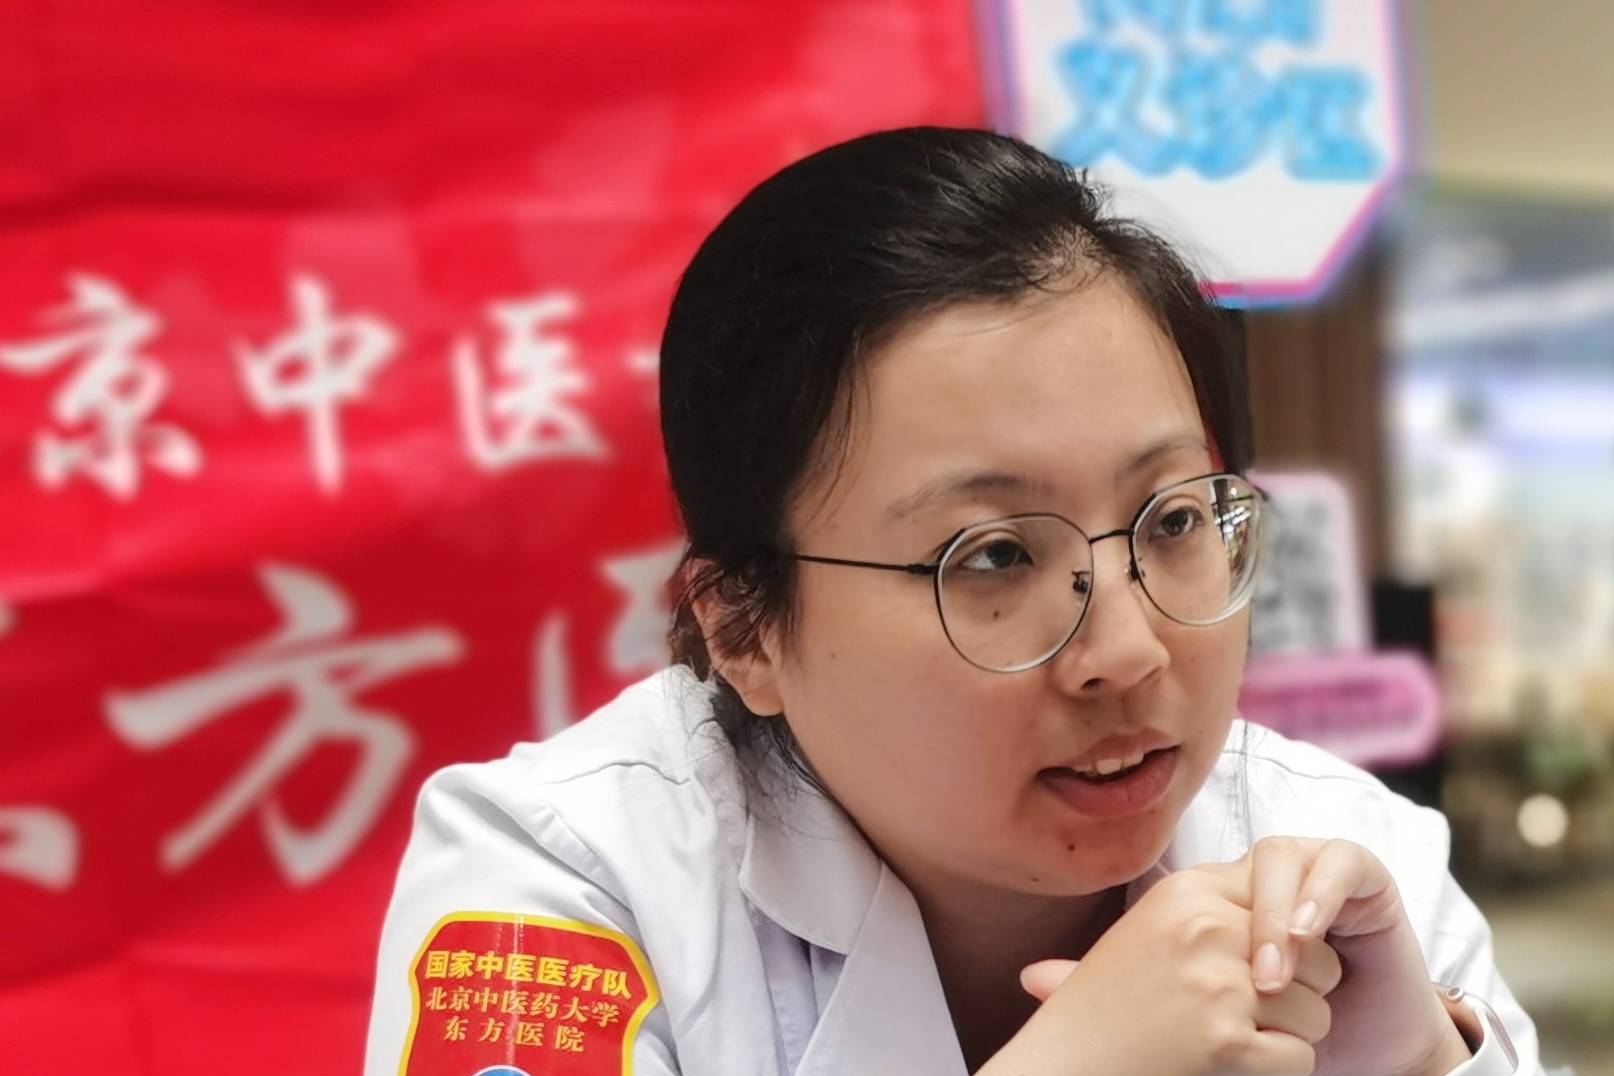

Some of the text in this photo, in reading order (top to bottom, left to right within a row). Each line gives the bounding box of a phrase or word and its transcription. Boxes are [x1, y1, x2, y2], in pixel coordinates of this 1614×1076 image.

[0, 271, 660, 500] 京中医
[425, 950, 632, 999] 国家中医医疗队
[426, 986, 620, 1028] 北京中医药大学
[444, 1015, 586, 1052] 东方医院
